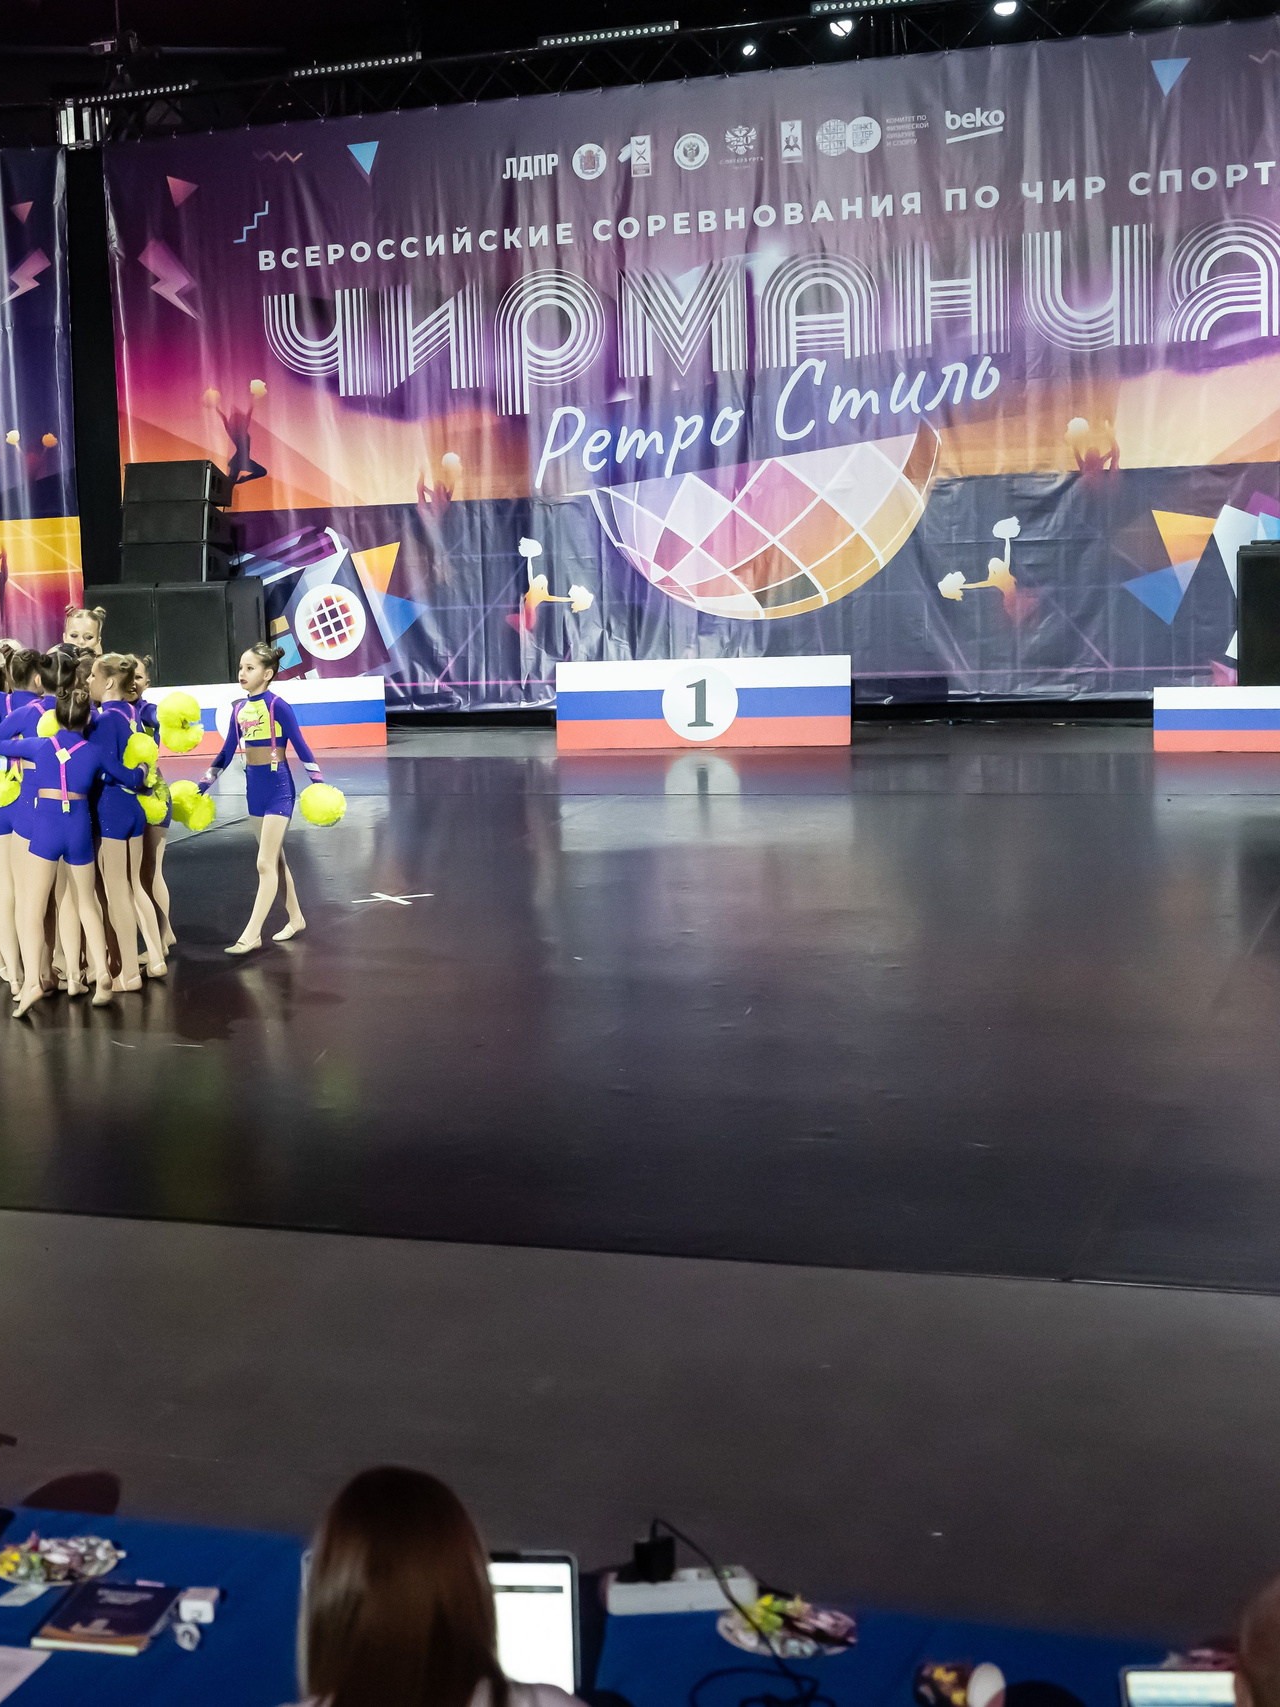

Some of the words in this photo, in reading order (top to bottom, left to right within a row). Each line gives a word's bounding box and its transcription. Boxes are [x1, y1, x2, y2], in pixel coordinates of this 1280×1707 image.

[945, 107, 1005, 130] beko
[502, 153, 559, 181] ЛДПР
[258, 222, 574, 271] ВСЕРОССИЙСКИЕ
[592, 191, 921, 242] СОРЕВНОВАНИЯ
[945, 185, 1000, 212] ПО
[1022, 175, 1106, 204] ЧИР
[534, 405, 745, 490] Ретро
[775, 355, 1001, 441] Стиль
[686, 678, 714, 727] 1
